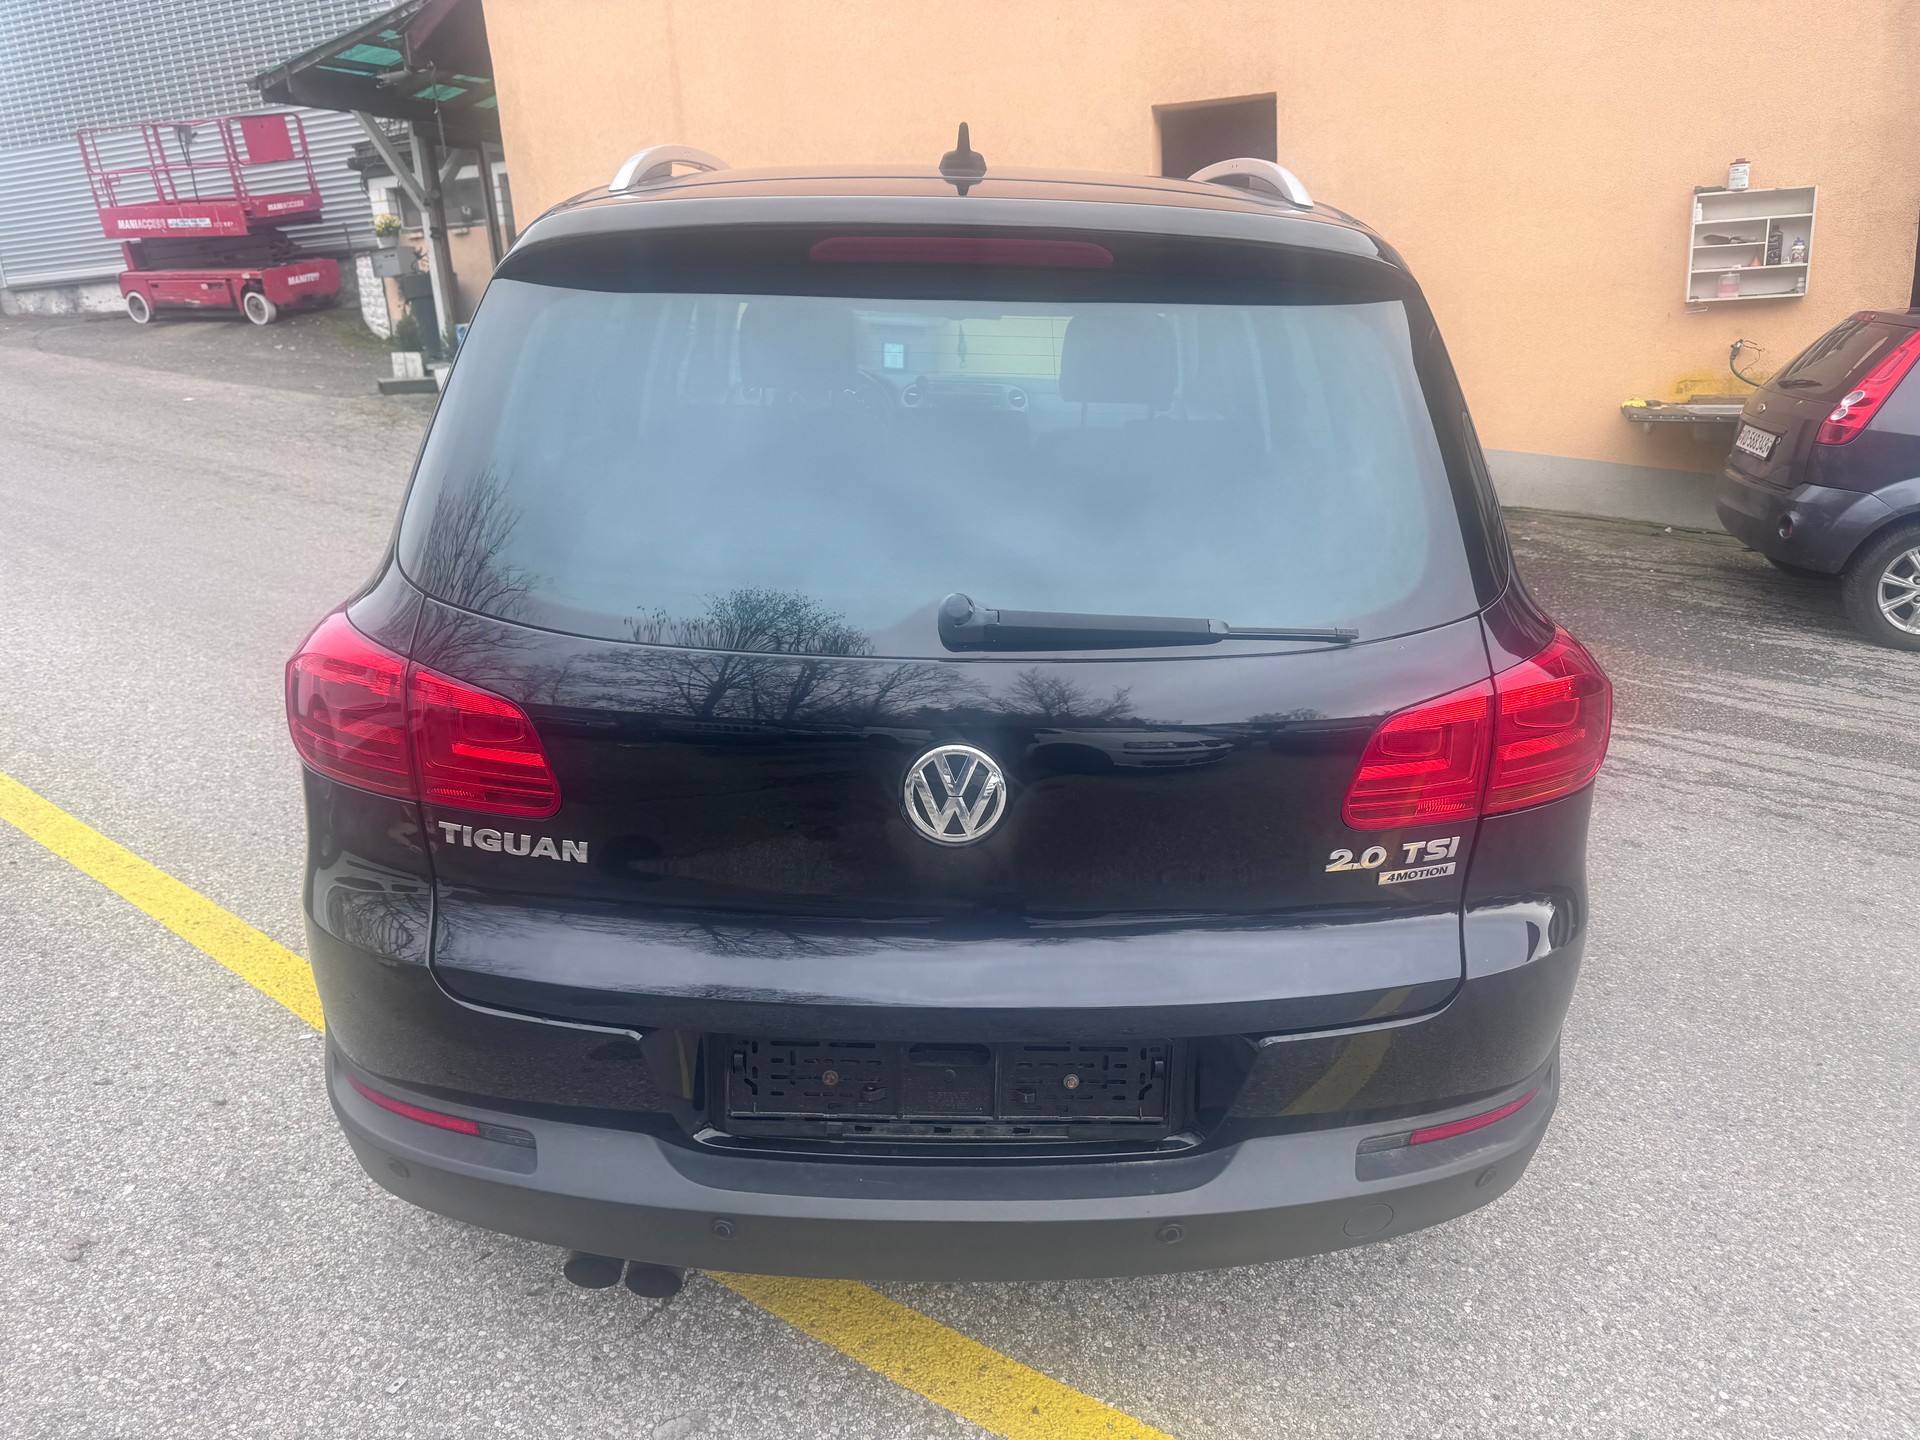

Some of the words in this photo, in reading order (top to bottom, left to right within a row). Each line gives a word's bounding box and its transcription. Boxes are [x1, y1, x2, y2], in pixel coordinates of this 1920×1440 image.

[438, 821, 588, 863] TIGUAN
[1325, 846, 1387, 872] 2.0
[1403, 836, 1460, 864] TSI
[1387, 866, 1448, 882] 4MOTION
